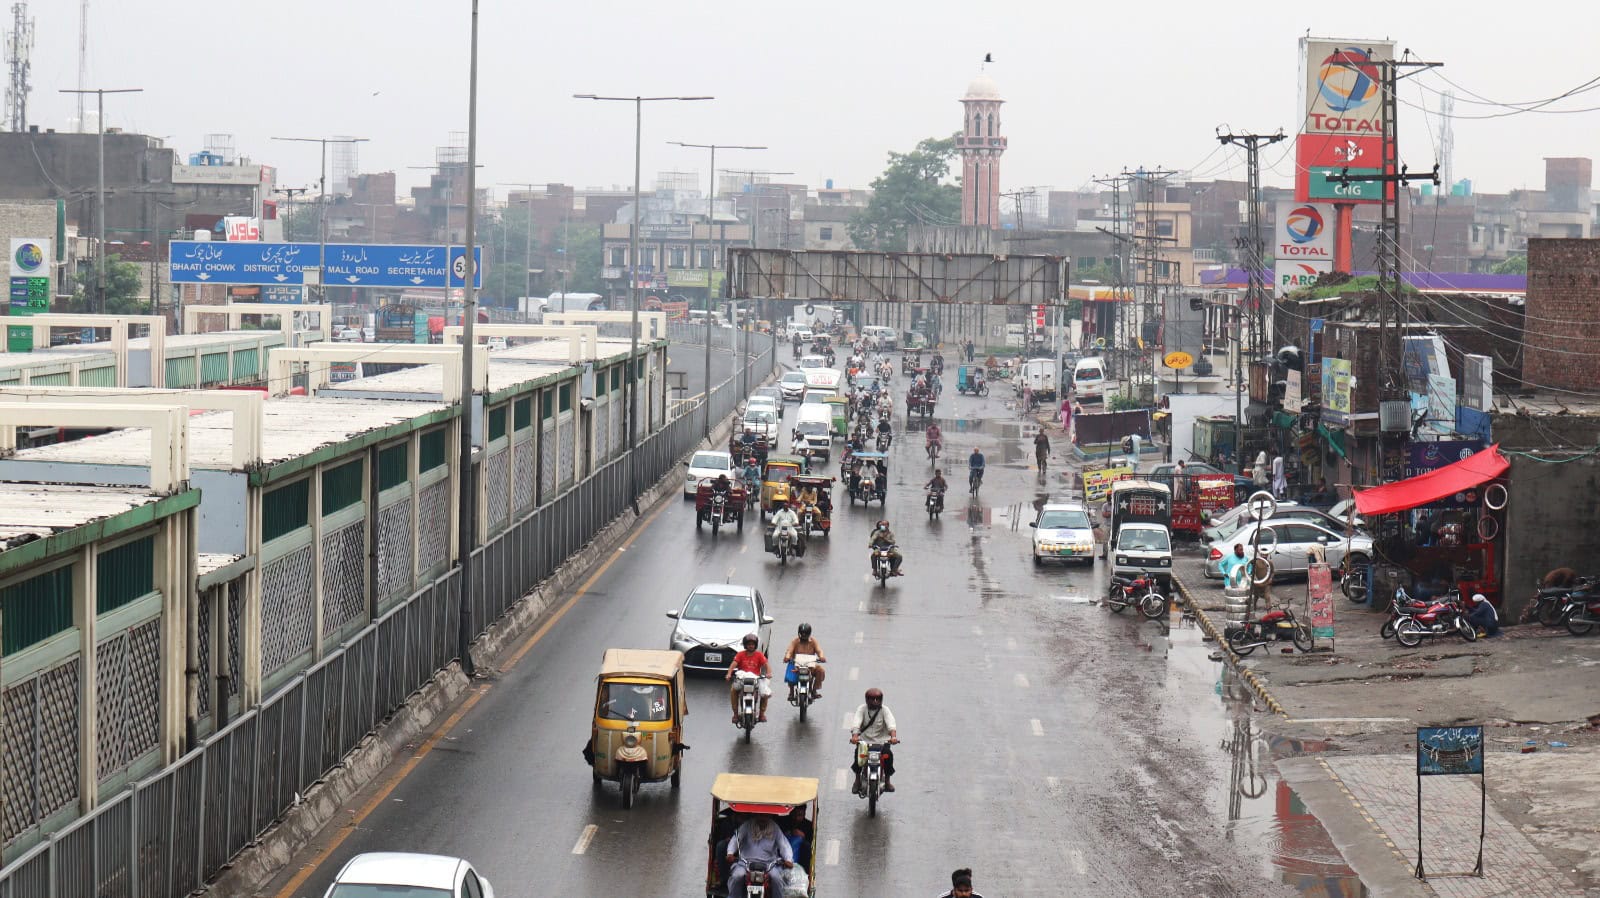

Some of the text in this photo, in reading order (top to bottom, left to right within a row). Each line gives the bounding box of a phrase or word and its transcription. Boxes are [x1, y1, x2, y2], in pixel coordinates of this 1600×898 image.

[1309, 113, 1383, 132] TOTAL
[1334, 185, 1361, 195] CNG
[185, 245, 204, 262] چوک
[284, 244, 301, 264] ضلع
[341, 248, 368, 263] مال روڈ
[1280, 244, 1328, 256] TOTAL
[244, 264, 281, 272] DISTRICT
[328, 266, 379, 275] MALL ROAD
[387, 267, 446, 276] SECRETARIAT
[1282, 274, 1318, 286] PARC
